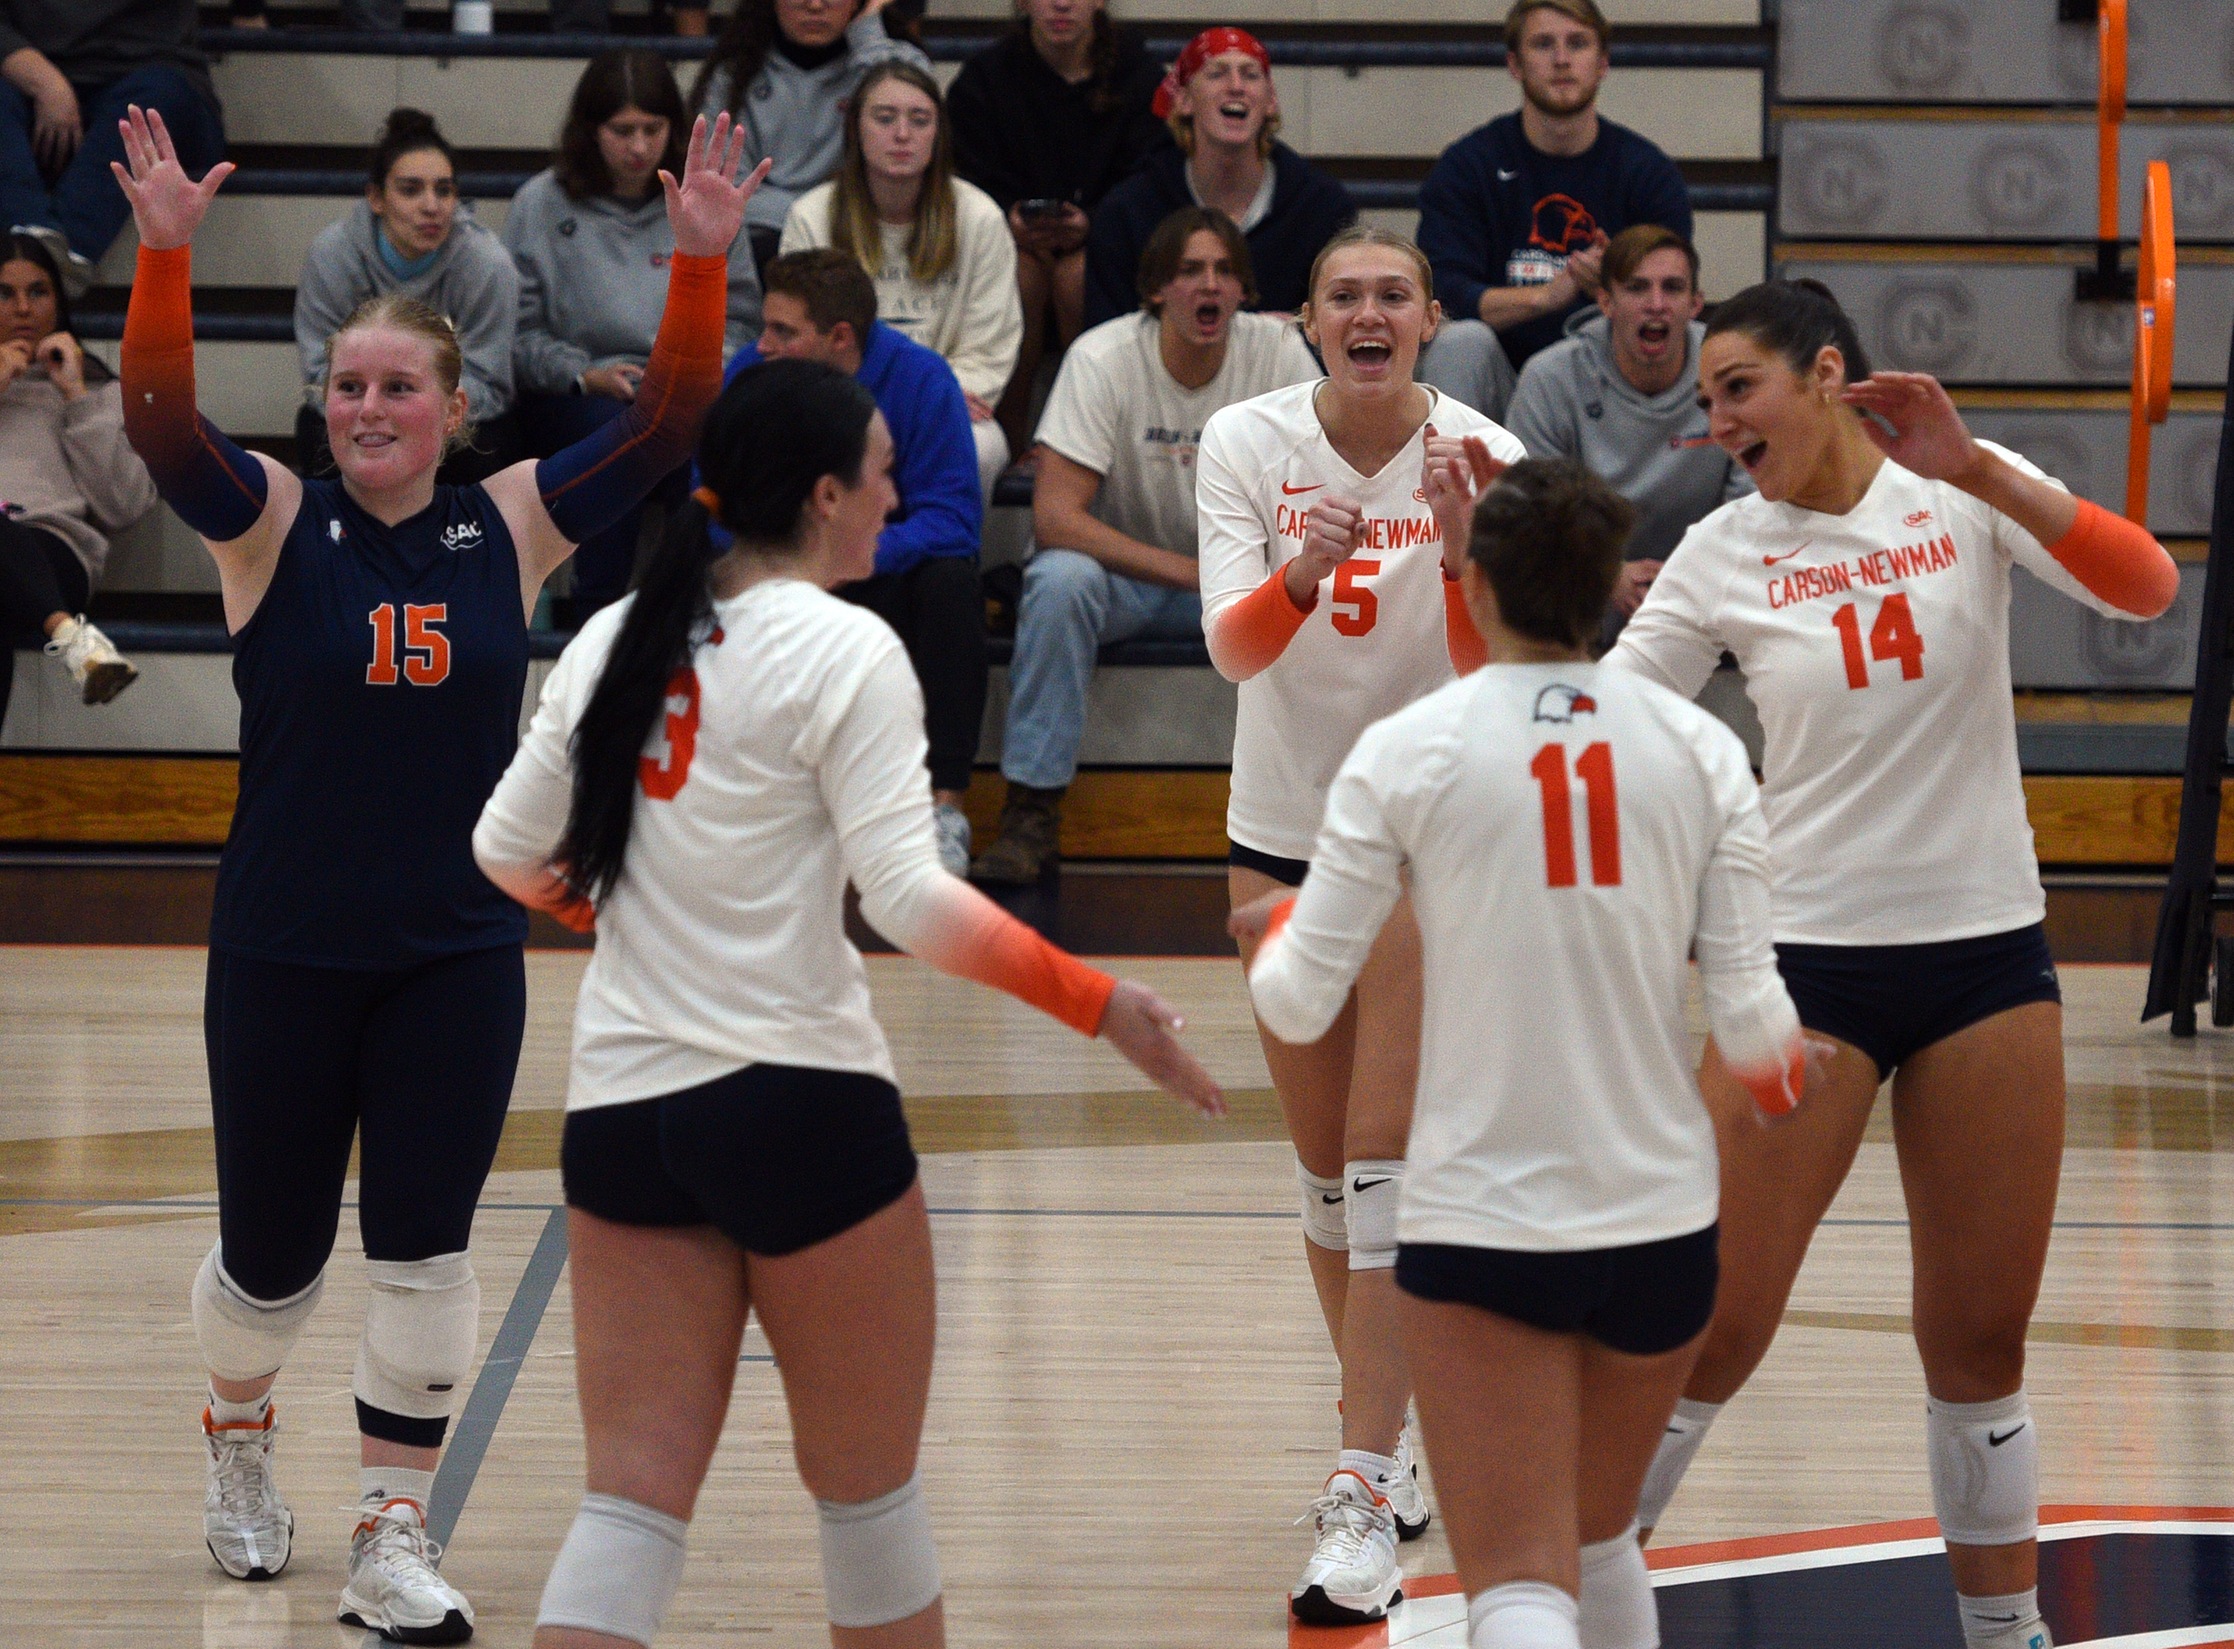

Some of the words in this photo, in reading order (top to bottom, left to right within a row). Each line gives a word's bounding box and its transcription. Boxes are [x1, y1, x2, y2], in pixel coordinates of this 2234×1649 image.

[1907, 510, 1932, 524] SAC
[1331, 558, 1381, 637] 5
[1767, 531, 1958, 610] CARSON-NEWMAN
[365, 602, 450, 686] 15
[1831, 591, 1925, 690] 14
[638, 666, 701, 802] 3
[1530, 742, 1622, 888] 11
